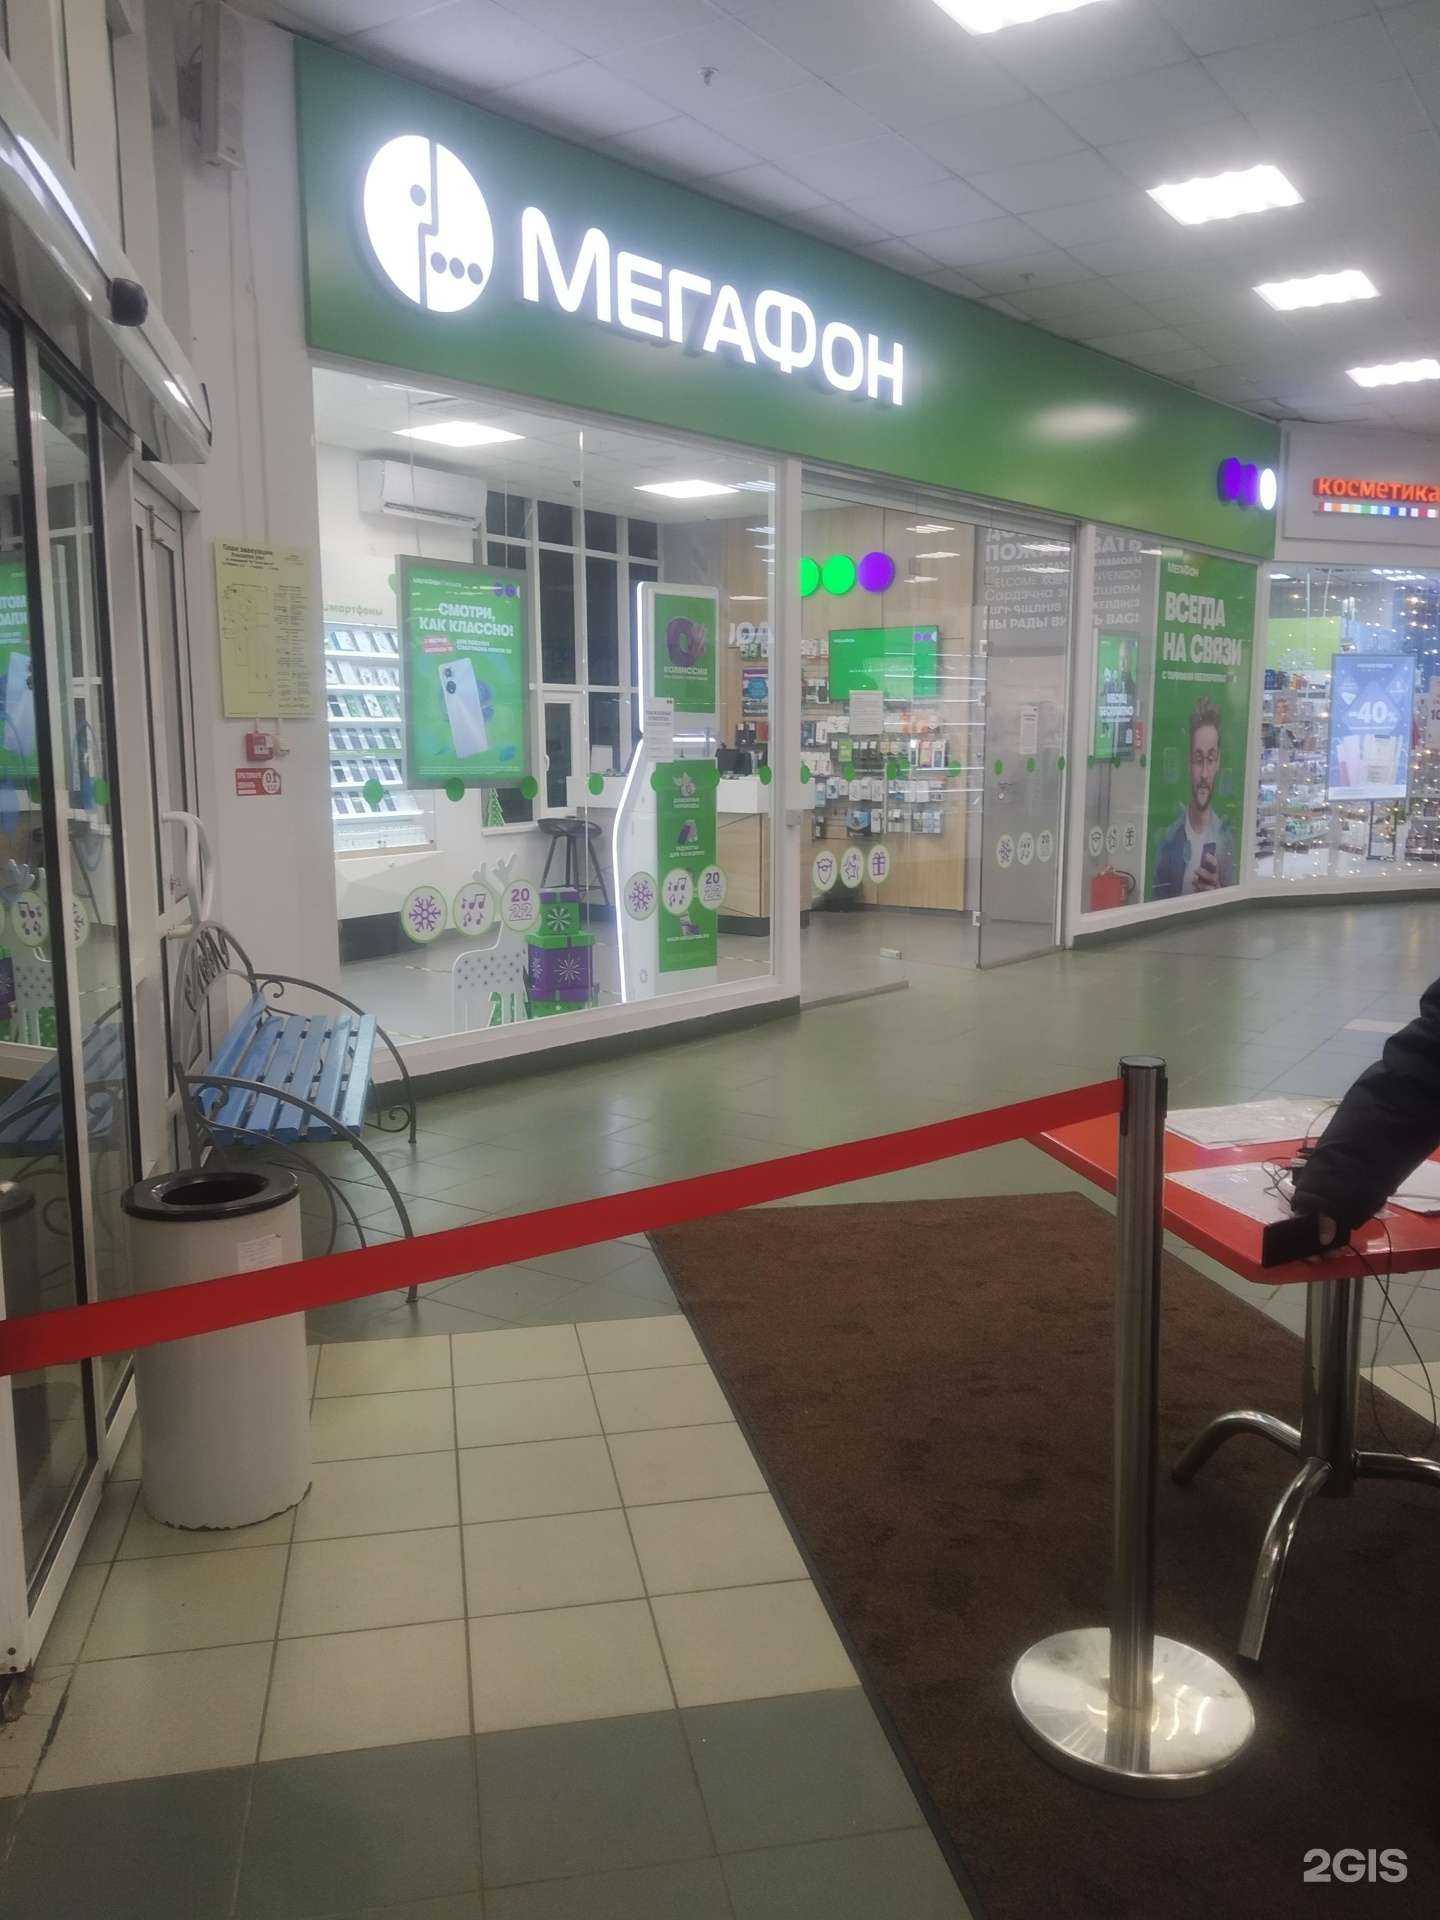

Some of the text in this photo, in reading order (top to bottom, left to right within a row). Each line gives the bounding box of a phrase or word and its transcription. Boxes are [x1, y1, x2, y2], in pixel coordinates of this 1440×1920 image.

[438, 602, 496, 622] СМОТРИ,
[1165, 591, 1227, 630] ВСЕГДА
[419, 617, 514, 637] КАК КЛАССНО!
[1163, 632, 1243, 667] НА СВЯЗИ
[705, 872, 720, 885] 20
[511, 888, 530, 903] 20
